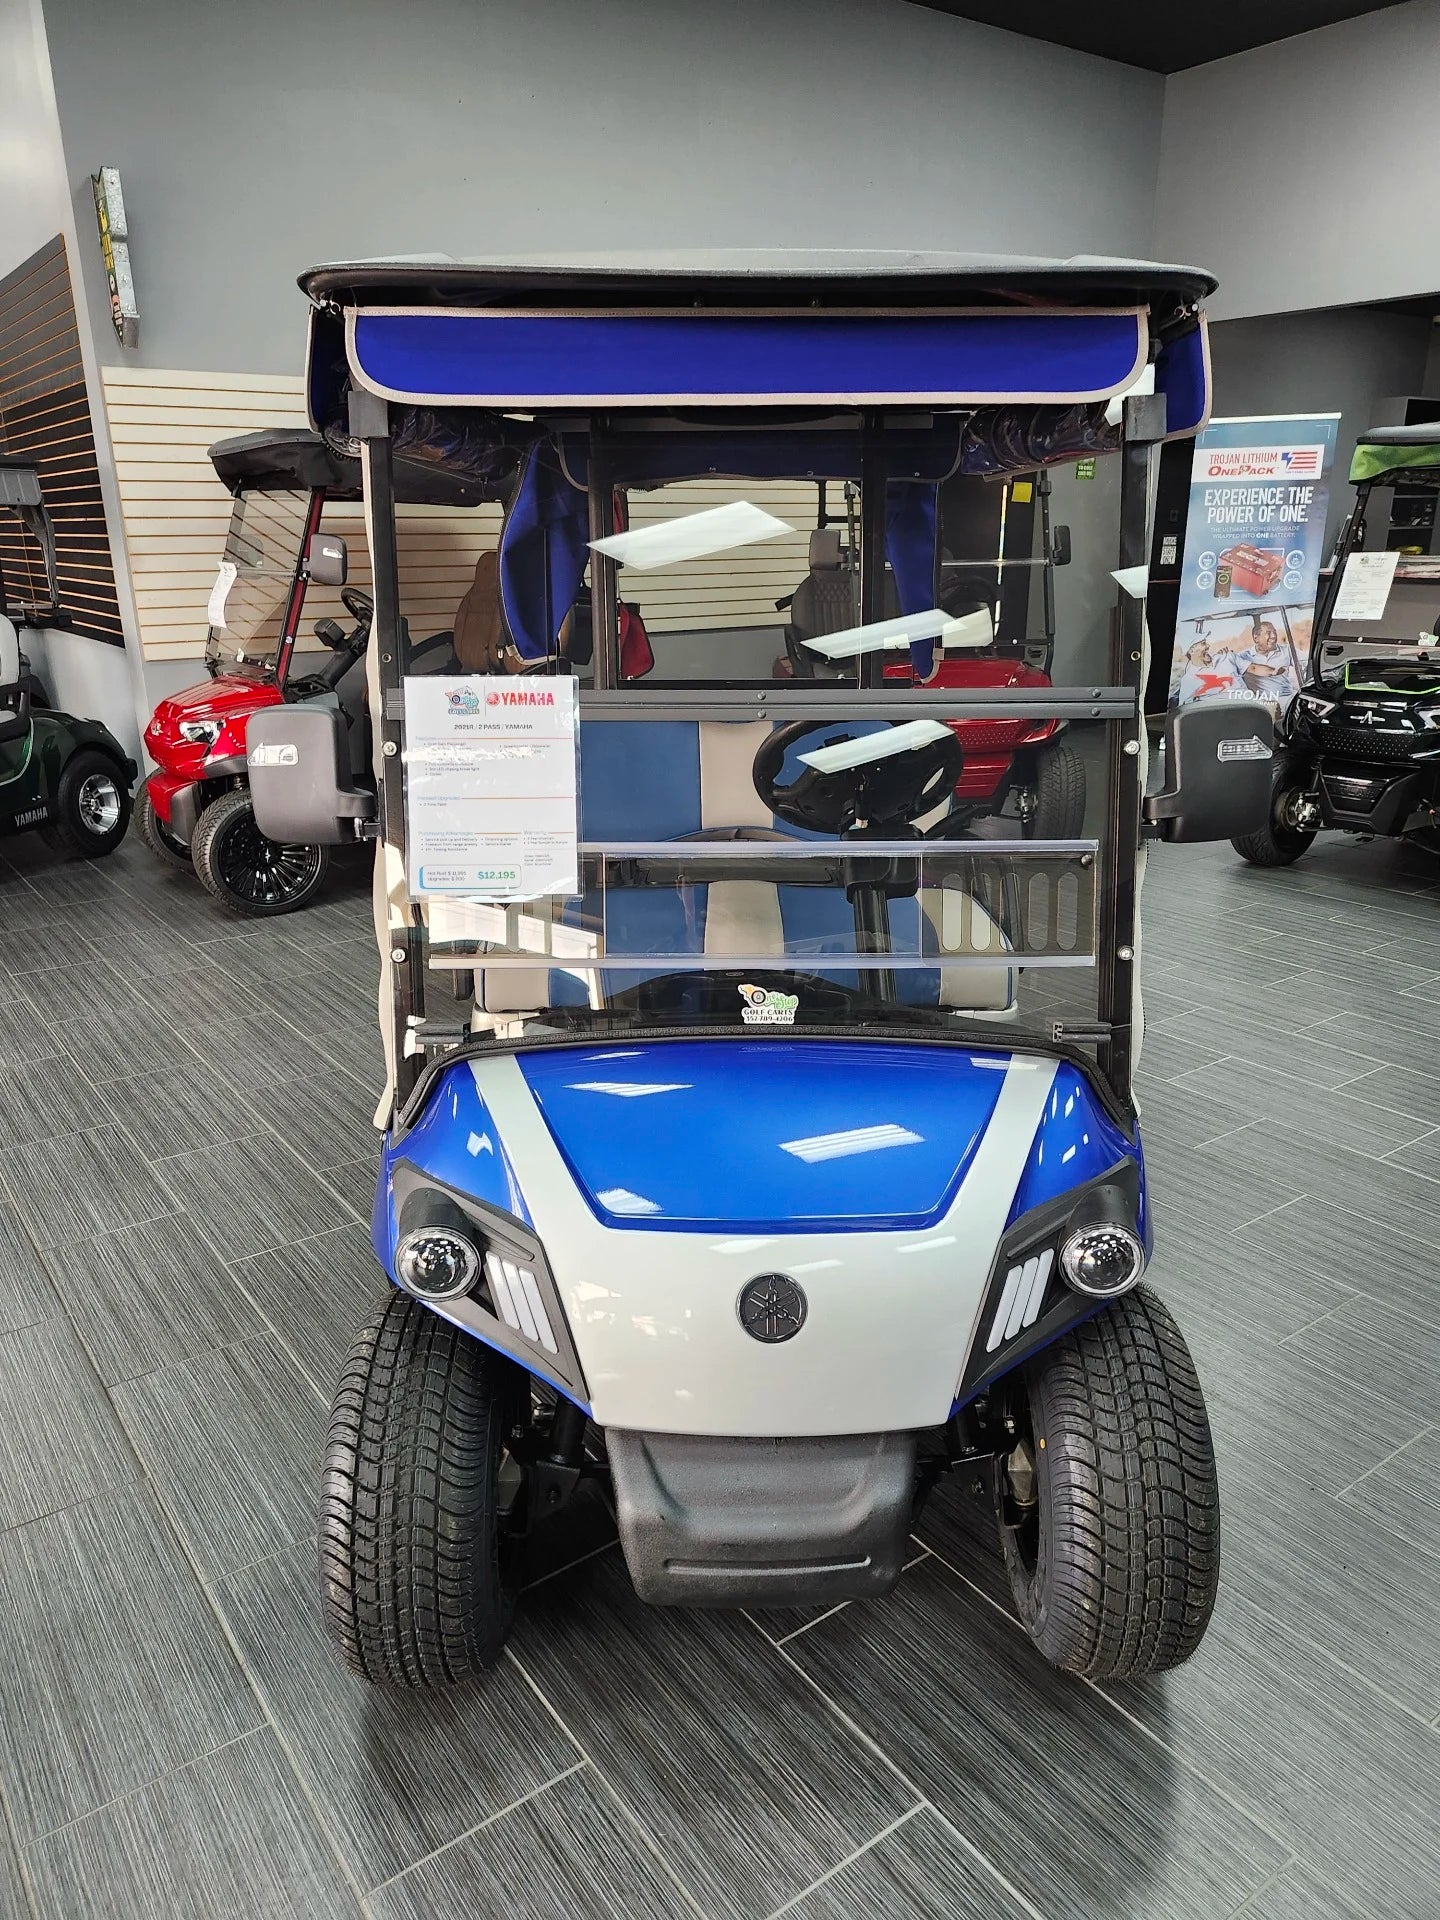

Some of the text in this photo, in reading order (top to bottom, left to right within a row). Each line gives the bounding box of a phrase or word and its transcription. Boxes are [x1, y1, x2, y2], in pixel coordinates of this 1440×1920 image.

[1210, 452, 1278, 465] TROJAN LITHIUM
[1204, 486, 1314, 506] EXPERIENCE THE
[1207, 504, 1309, 523] POWER OF ONE.
[501, 692, 555, 706] YAMAHA
[1227, 689, 1279, 701] TROJAN
[14, 806, 48, 827] YAMAHA
